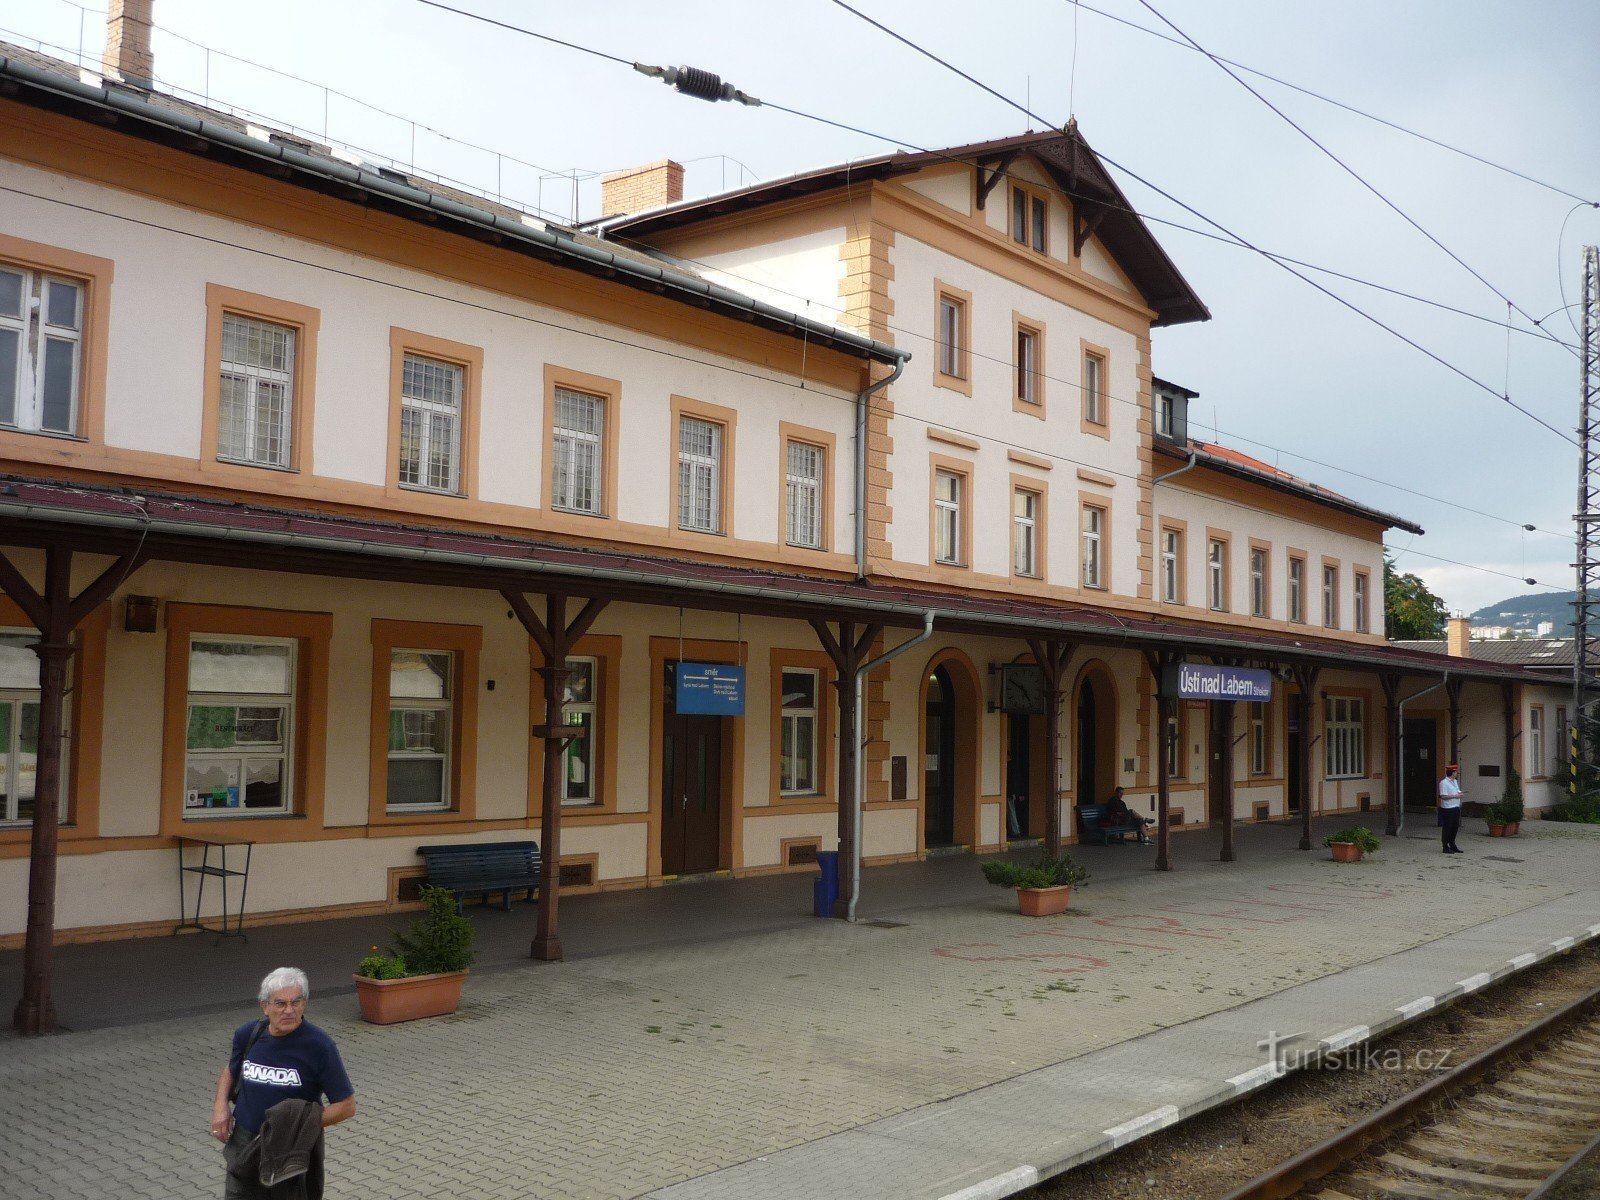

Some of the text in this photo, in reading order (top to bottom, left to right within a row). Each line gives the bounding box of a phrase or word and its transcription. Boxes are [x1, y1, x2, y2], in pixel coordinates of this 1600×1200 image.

[1180, 667, 1200, 693] Ústí
[1201, 673, 1220, 694] nad
[1221, 673, 1253, 696] Labem
[243, 1060, 302, 1086] CANADA
